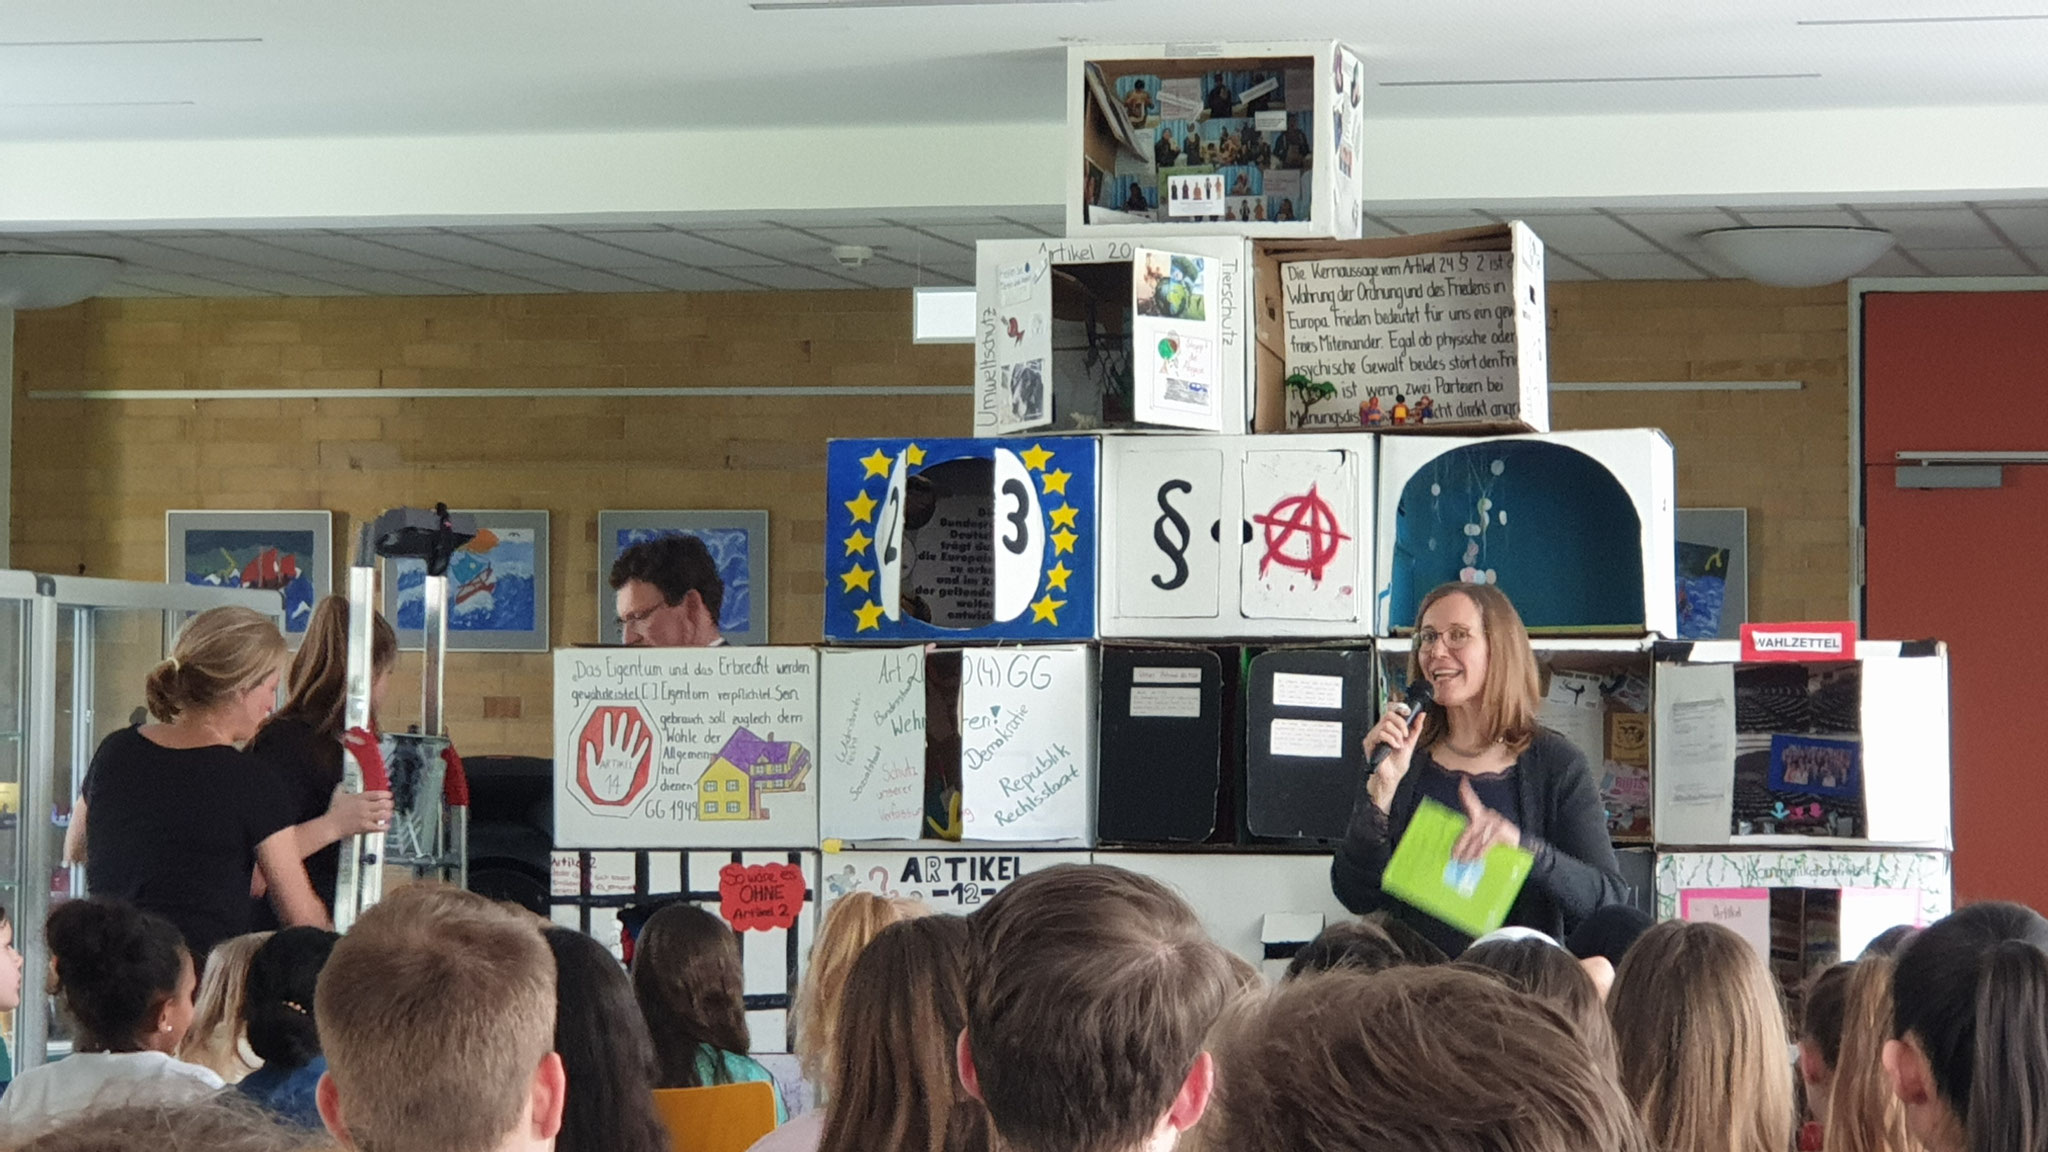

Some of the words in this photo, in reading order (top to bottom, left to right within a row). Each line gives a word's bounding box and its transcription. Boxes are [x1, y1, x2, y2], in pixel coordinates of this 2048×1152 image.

[1108, 242, 1145, 259] 20
[1287, 265, 1306, 284] Die
[1311, 262, 1380, 288] Kernaussage
[1381, 264, 1400, 277] vom
[1403, 257, 1437, 275] Artikel
[1440, 256, 1455, 273] 24
[1477, 255, 1485, 271] 2
[1490, 255, 1503, 271] ist
[1221, 259, 1239, 347] Tierschutz
[1286, 286, 1336, 312] Wahrung
[1337, 285, 1354, 302] der
[1357, 282, 1405, 309] Ordnung
[1404, 280, 1424, 298] und
[1426, 281, 1445, 297] des
[1445, 277, 1491, 295] Friedens
[1493, 281, 1506, 293] in
[1373, 306, 1420, 325] bedeutet
[1423, 303, 1444, 323] für
[1448, 309, 1471, 322] uns
[1473, 307, 1492, 320] ein
[1494, 305, 1513, 329] gew
[1387, 329, 1417, 357] Egal
[1418, 331, 1433, 346] ob
[1436, 329, 1488, 352] physische
[1490, 326, 1515, 345] oder
[976, 307, 998, 428] Umweltschutz
[1360, 355, 1406, 375] Gewalt
[1409, 355, 1446, 373] beides
[1480, 354, 1499, 369] den
[1341, 380, 1358, 399] ist
[1365, 384, 1400, 398] wenn
[1405, 382, 1431, 395] zwei
[1435, 378, 1483, 394] Parteien
[1486, 375, 1503, 392] bei
[1456, 400, 1488, 418] direkt
[940, 518, 994, 529] Bundesr
[1001, 478, 1030, 555] 3
[915, 585, 935, 596] der
[937, 575, 959, 585] und
[1755, 637, 1841, 650] WAHLZETTEL
[605, 655, 663, 685] Eigentum
[669, 662, 690, 676] und
[694, 662, 714, 676] das
[719, 655, 770, 676] Erbrecht
[776, 659, 810, 675] werden
[877, 654, 902, 685] Art
[1007, 654, 1053, 690] GG
[661, 680, 710, 706] Eigentum
[709, 711, 726, 724] soll
[776, 708, 804, 724] dem
[667, 728, 698, 743] Wohle
[704, 729, 722, 743] der
[963, 704, 1029, 771] Demokratie
[598, 759, 635, 770] ARTIKEL
[998, 742, 1072, 798] Republik
[604, 774, 621, 795] 14
[993, 763, 1080, 827] Rechtsstaat
[645, 799, 667, 820] GG
[670, 800, 699, 821] 1949
[723, 867, 746, 887] So
[780, 870, 798, 881] es
[900, 856, 1021, 883] ARTIKEL
[739, 883, 786, 905] OHNE
[732, 906, 775, 920] Artikel
[778, 903, 790, 917] 2
